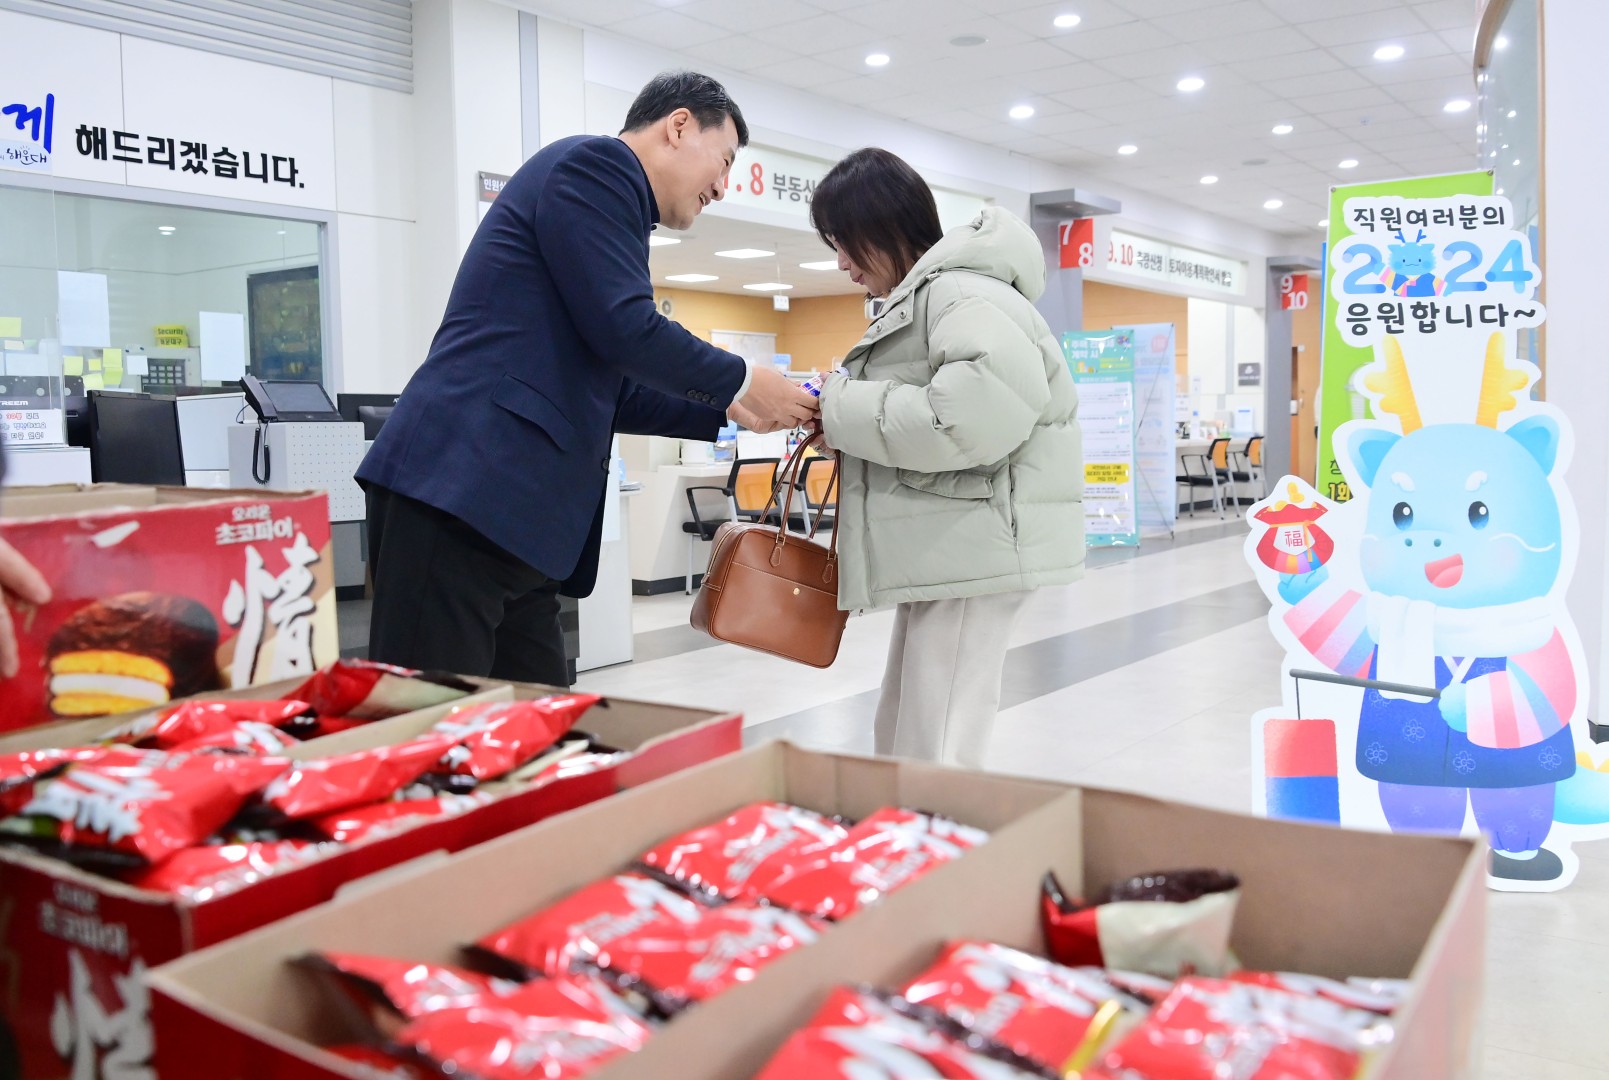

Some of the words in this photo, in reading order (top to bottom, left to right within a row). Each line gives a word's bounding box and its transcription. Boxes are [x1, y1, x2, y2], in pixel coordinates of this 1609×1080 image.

[75, 123, 306, 189] 해드리겠습니다.
[723, 162, 764, 196] .8
[1353, 204, 1506, 233] 직원여러분의
[1060, 221, 1074, 246] 7
[1078, 242, 1093, 268] 8
[1281, 277, 1293, 293] 9
[1287, 291, 1308, 310] 10
[1345, 301, 1537, 336] 응원합니다~
[215, 515, 295, 546] 초코파이
[1284, 530, 1303, 547] 福
